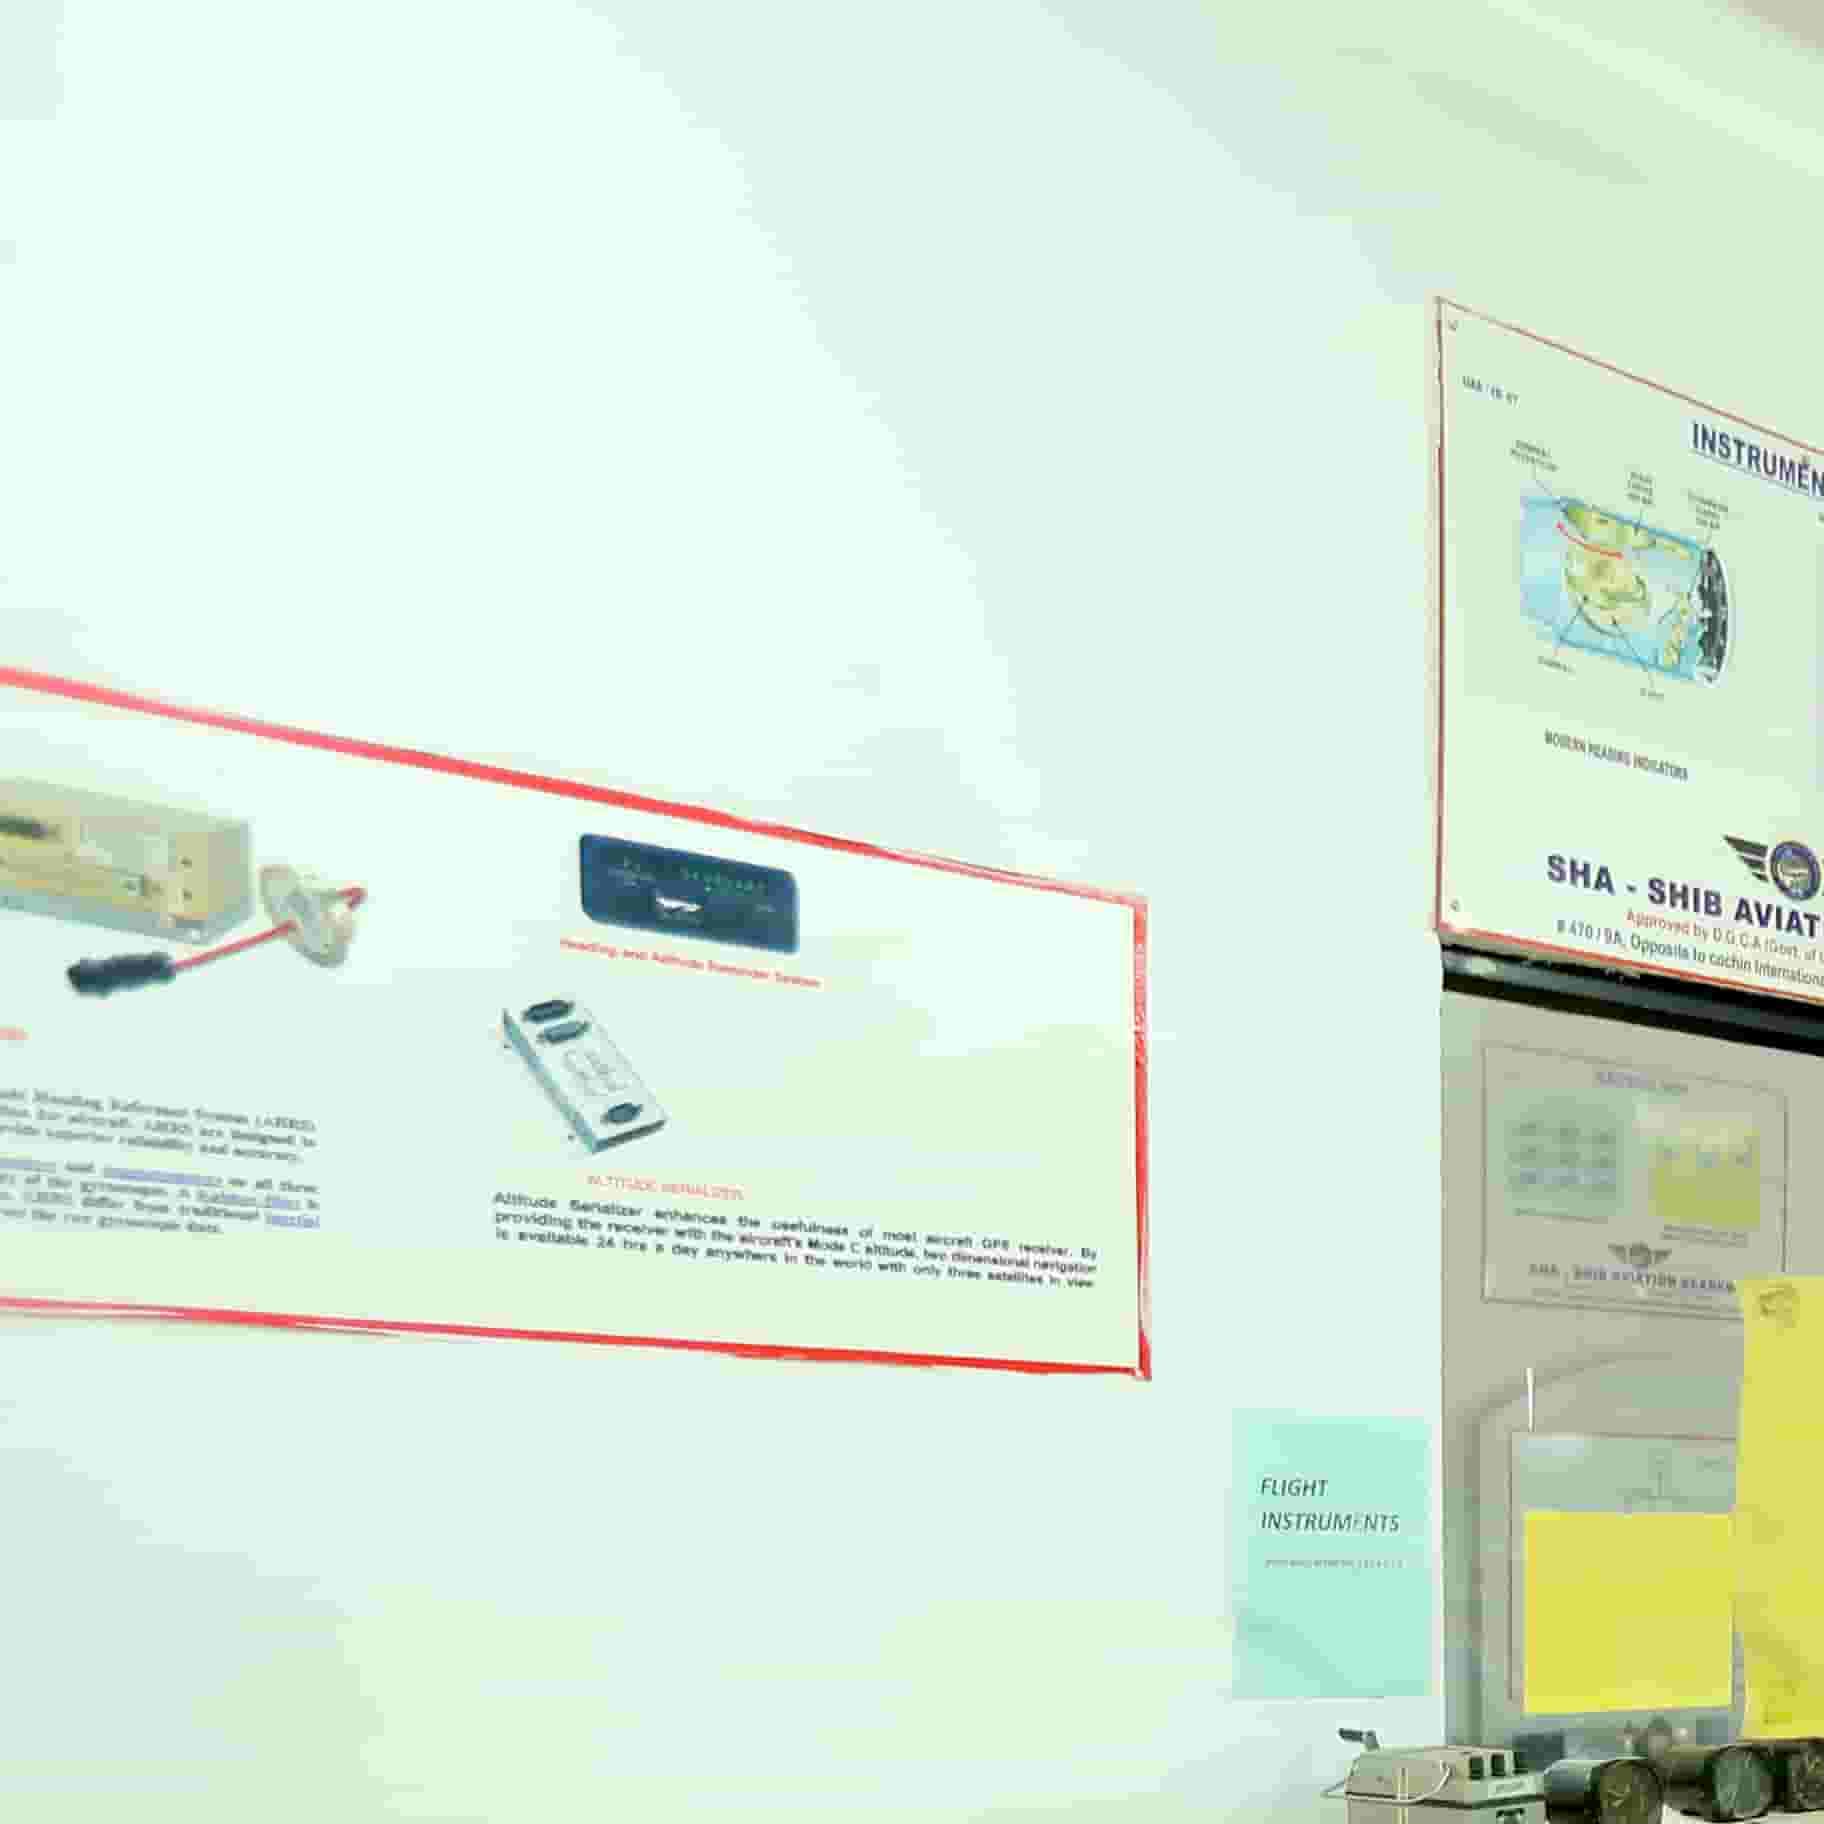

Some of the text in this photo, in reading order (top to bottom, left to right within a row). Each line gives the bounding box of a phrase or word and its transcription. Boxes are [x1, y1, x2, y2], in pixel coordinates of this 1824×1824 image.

[1547, 855, 1616, 896] SHA
[1648, 878, 1722, 917] SHIB
[1627, 908, 1690, 936] Approved
[1694, 927, 1708, 942] by
[1631, 931, 1689, 961] Opposite
[1694, 945, 1707, 963] to
[495, 1211, 573, 1231] providing
[578, 1217, 601, 1232] the
[675, 1227, 706, 1241] with
[711, 1230, 734, 1243] the
[739, 1215, 760, 1229] the
[672, 1241, 700, 1258] day
[1260, 1476, 1329, 1497] FLIGHT
[1261, 1510, 1401, 1533] INSTRUMENTS
